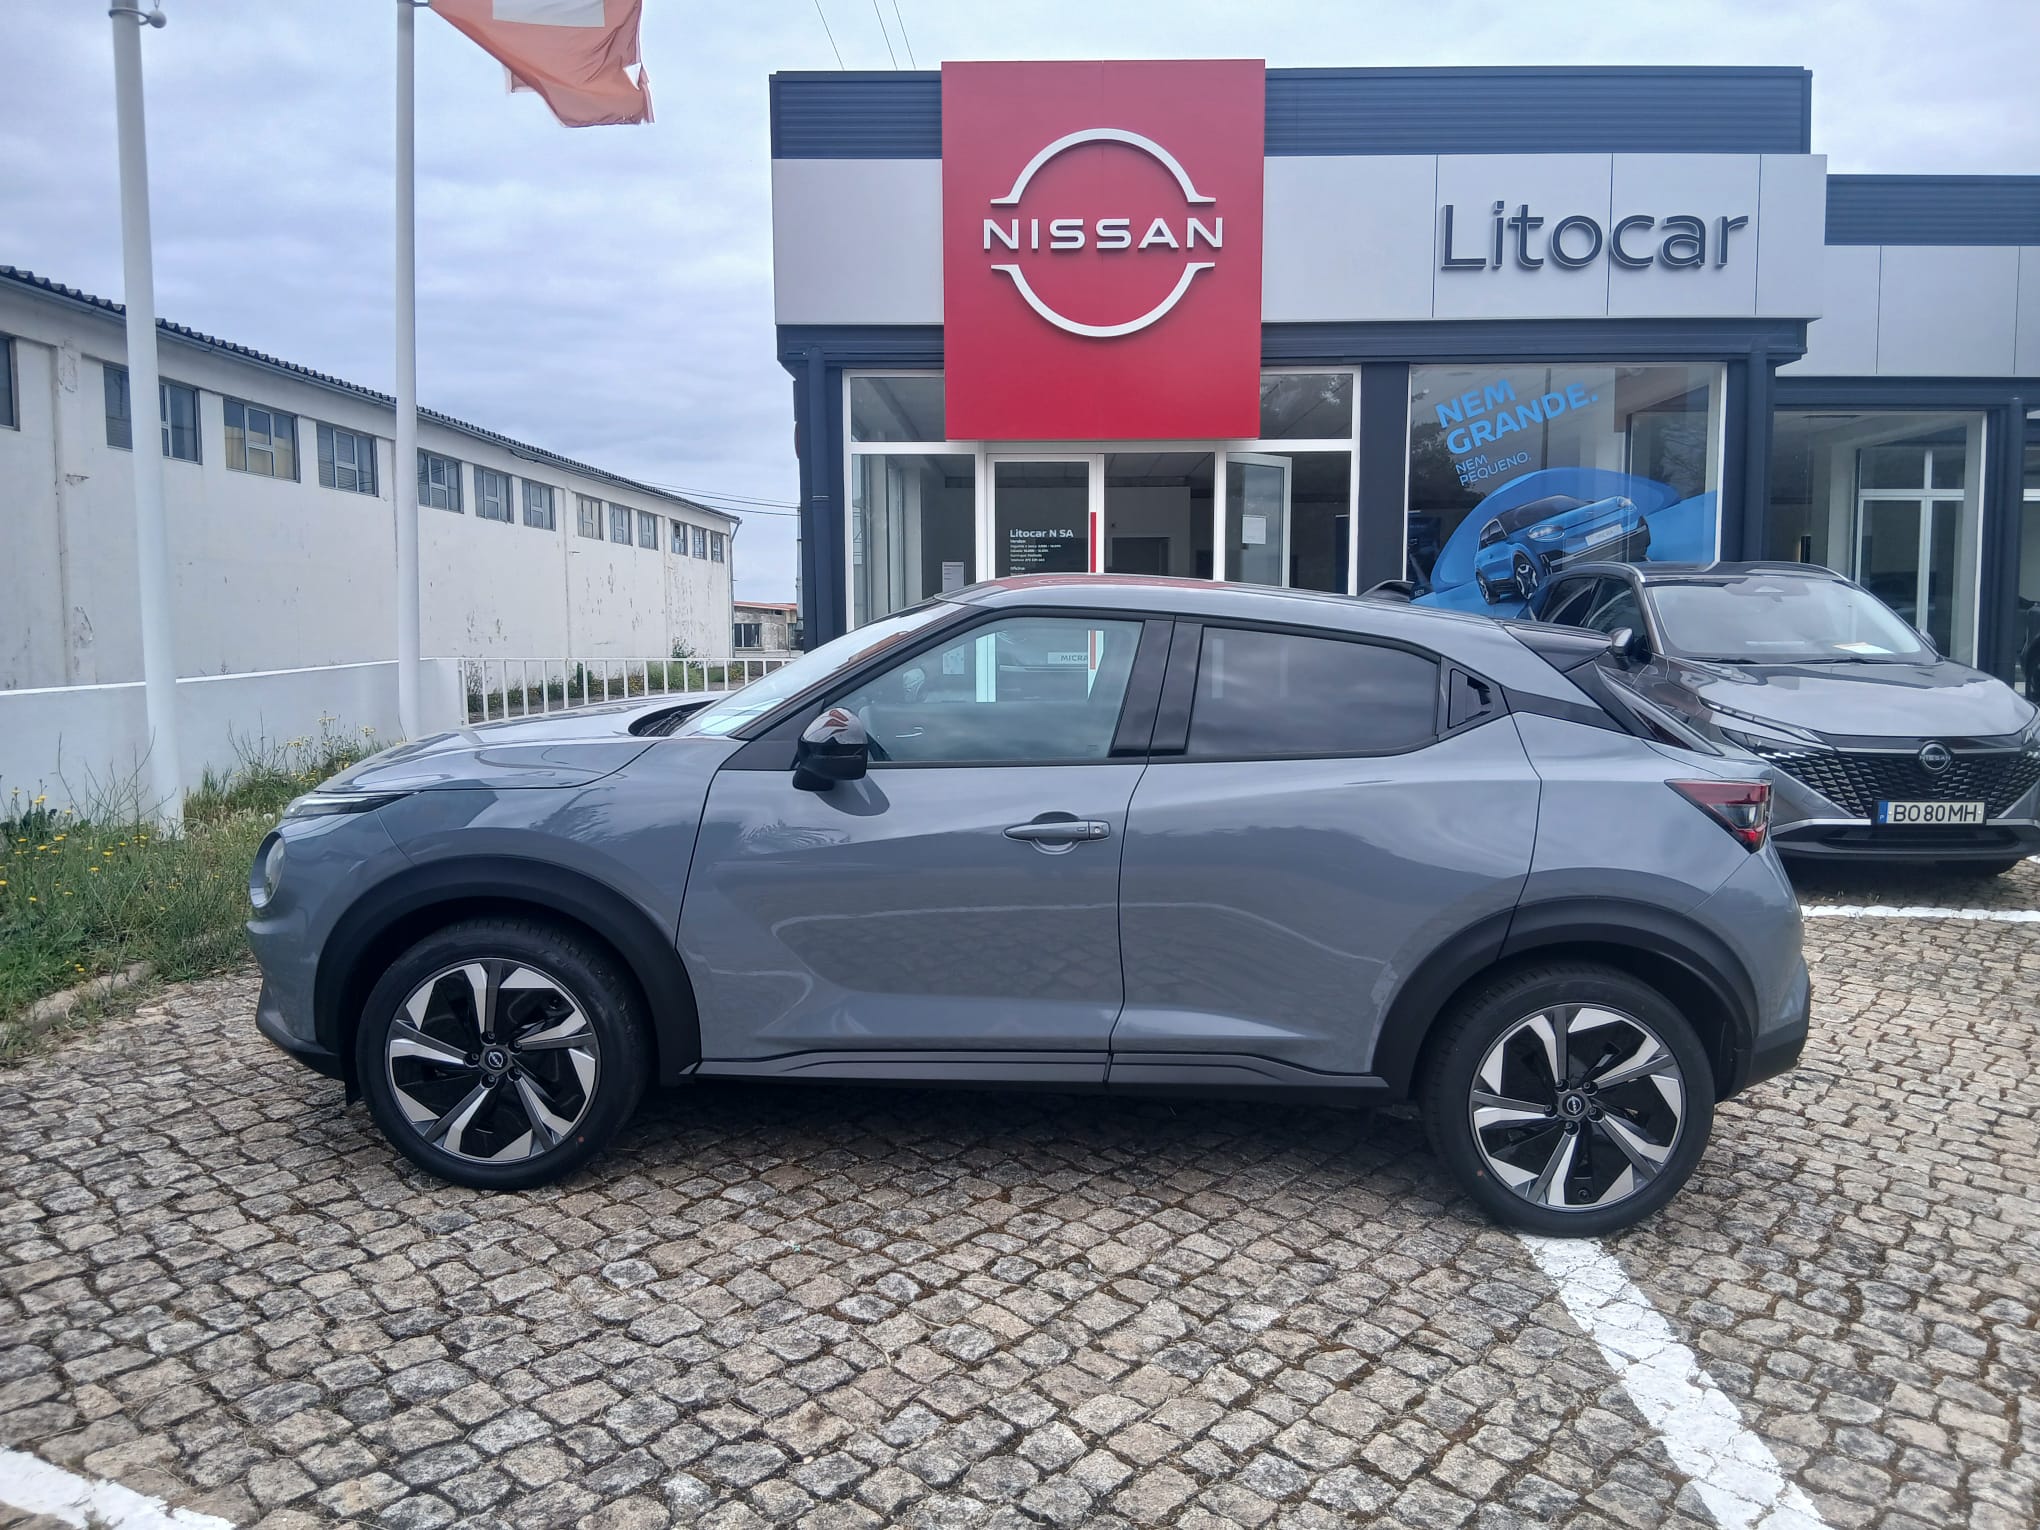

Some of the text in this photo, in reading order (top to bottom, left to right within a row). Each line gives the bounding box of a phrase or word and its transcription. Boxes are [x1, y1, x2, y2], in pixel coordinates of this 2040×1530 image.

[983, 217, 1224, 251] NISSAN
[1441, 200, 1749, 271] Litocar
[1435, 379, 1517, 429] NEM
[1446, 382, 1599, 455] GRANDE.
[1455, 454, 1488, 475] NEM
[1459, 451, 1532, 487] PEQUENO.
[1009, 528, 1074, 538] Litocar N SA
